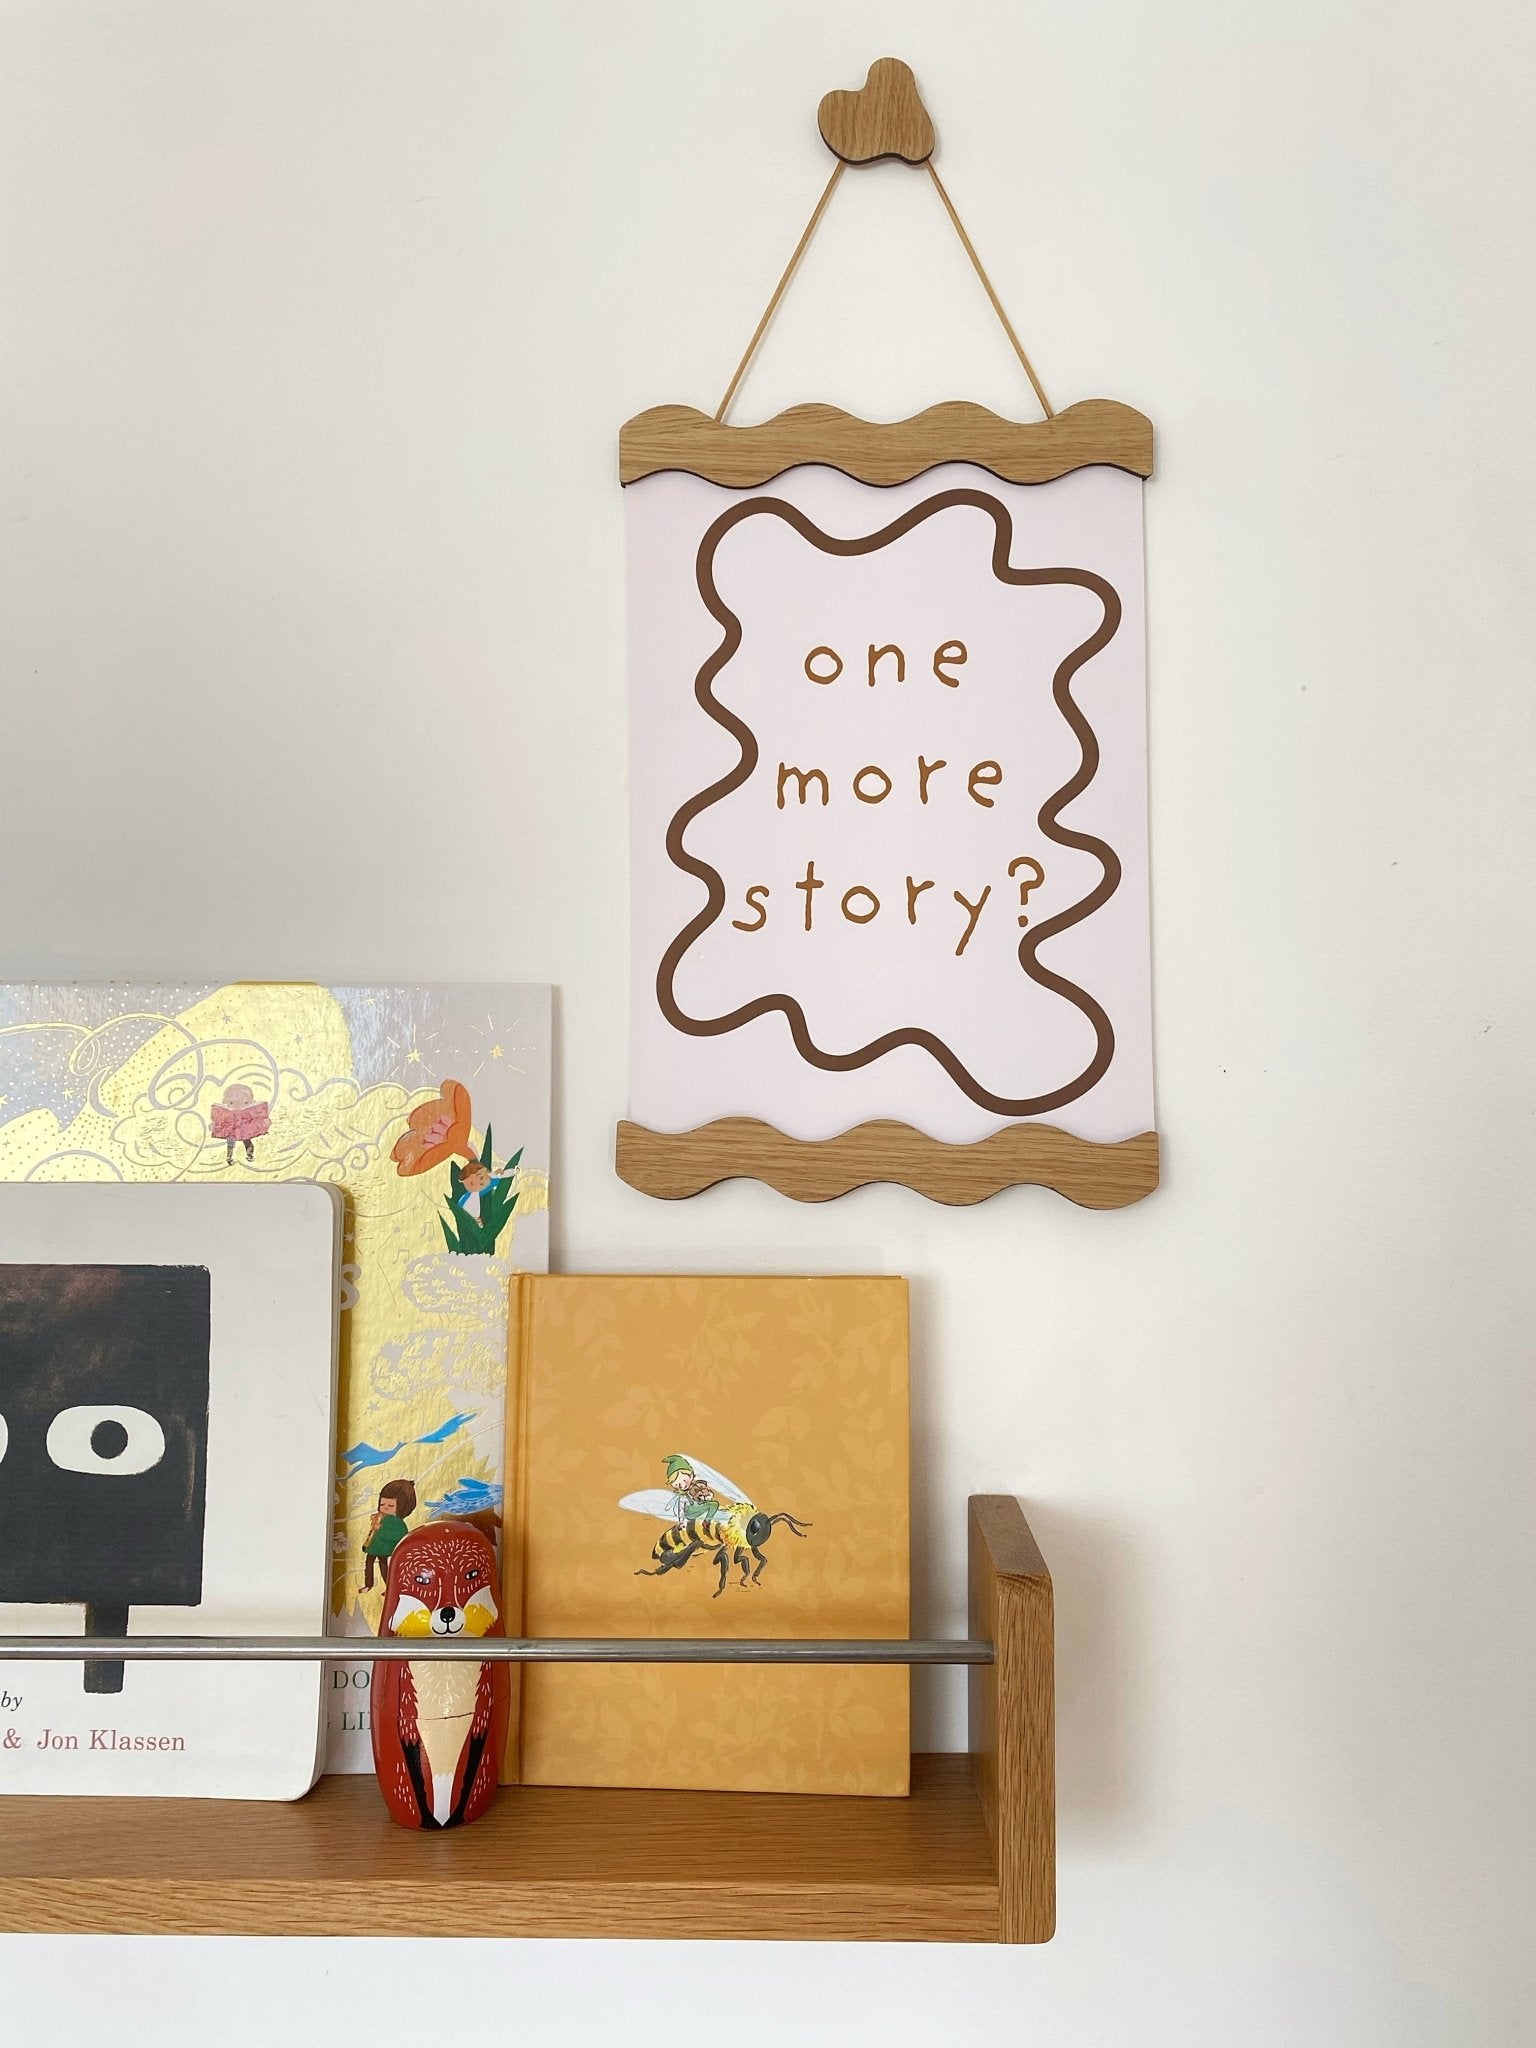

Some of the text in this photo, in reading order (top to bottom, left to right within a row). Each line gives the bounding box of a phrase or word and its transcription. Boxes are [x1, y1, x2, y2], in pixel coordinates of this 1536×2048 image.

[804, 639, 969, 689] one
[776, 755, 1003, 809] more
[732, 855, 1046, 956] story?
[0, 1690, 23, 1712] by
[341, 1711, 371, 1731] LI
[2, 1728, 186, 1751] & Jon Klassen
